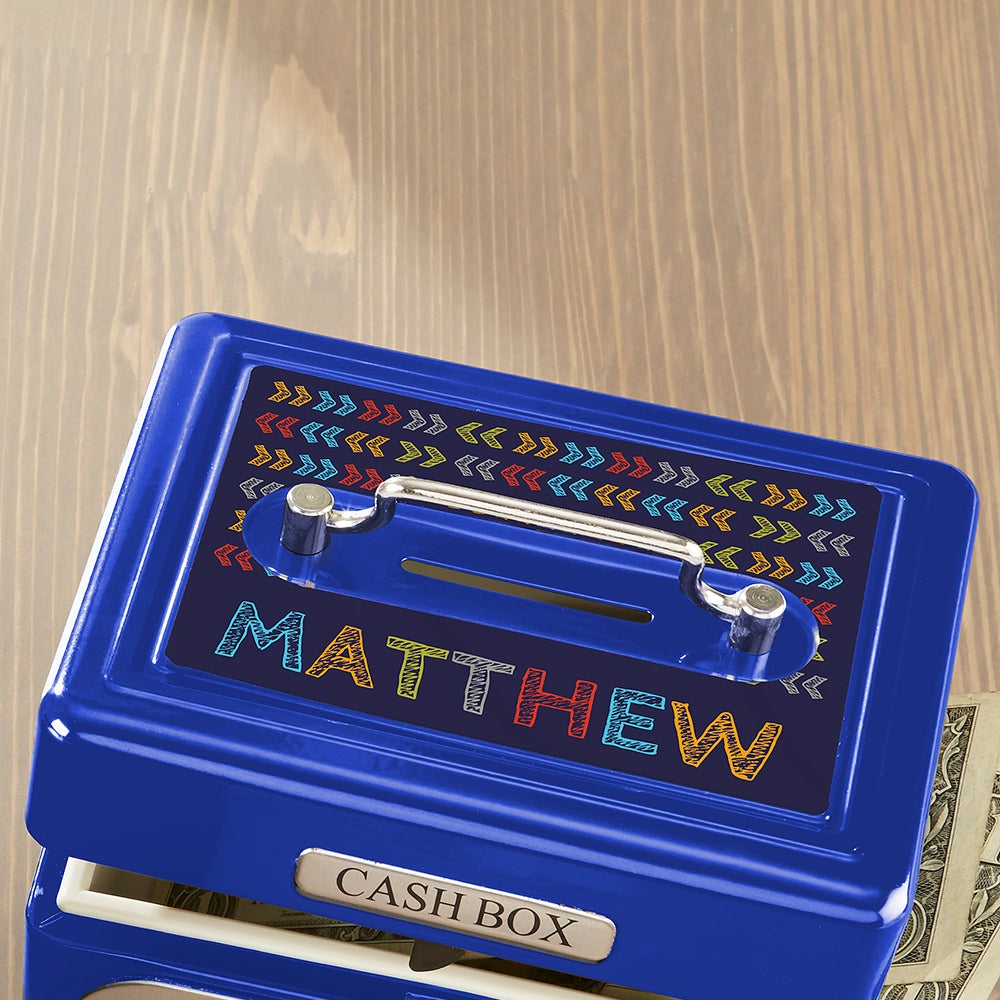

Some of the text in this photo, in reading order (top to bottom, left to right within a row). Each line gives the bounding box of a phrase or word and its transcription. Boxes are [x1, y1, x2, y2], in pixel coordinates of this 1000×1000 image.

[215, 601, 783, 781] MATTHEW
[336, 867, 579, 947] CASH BOX
